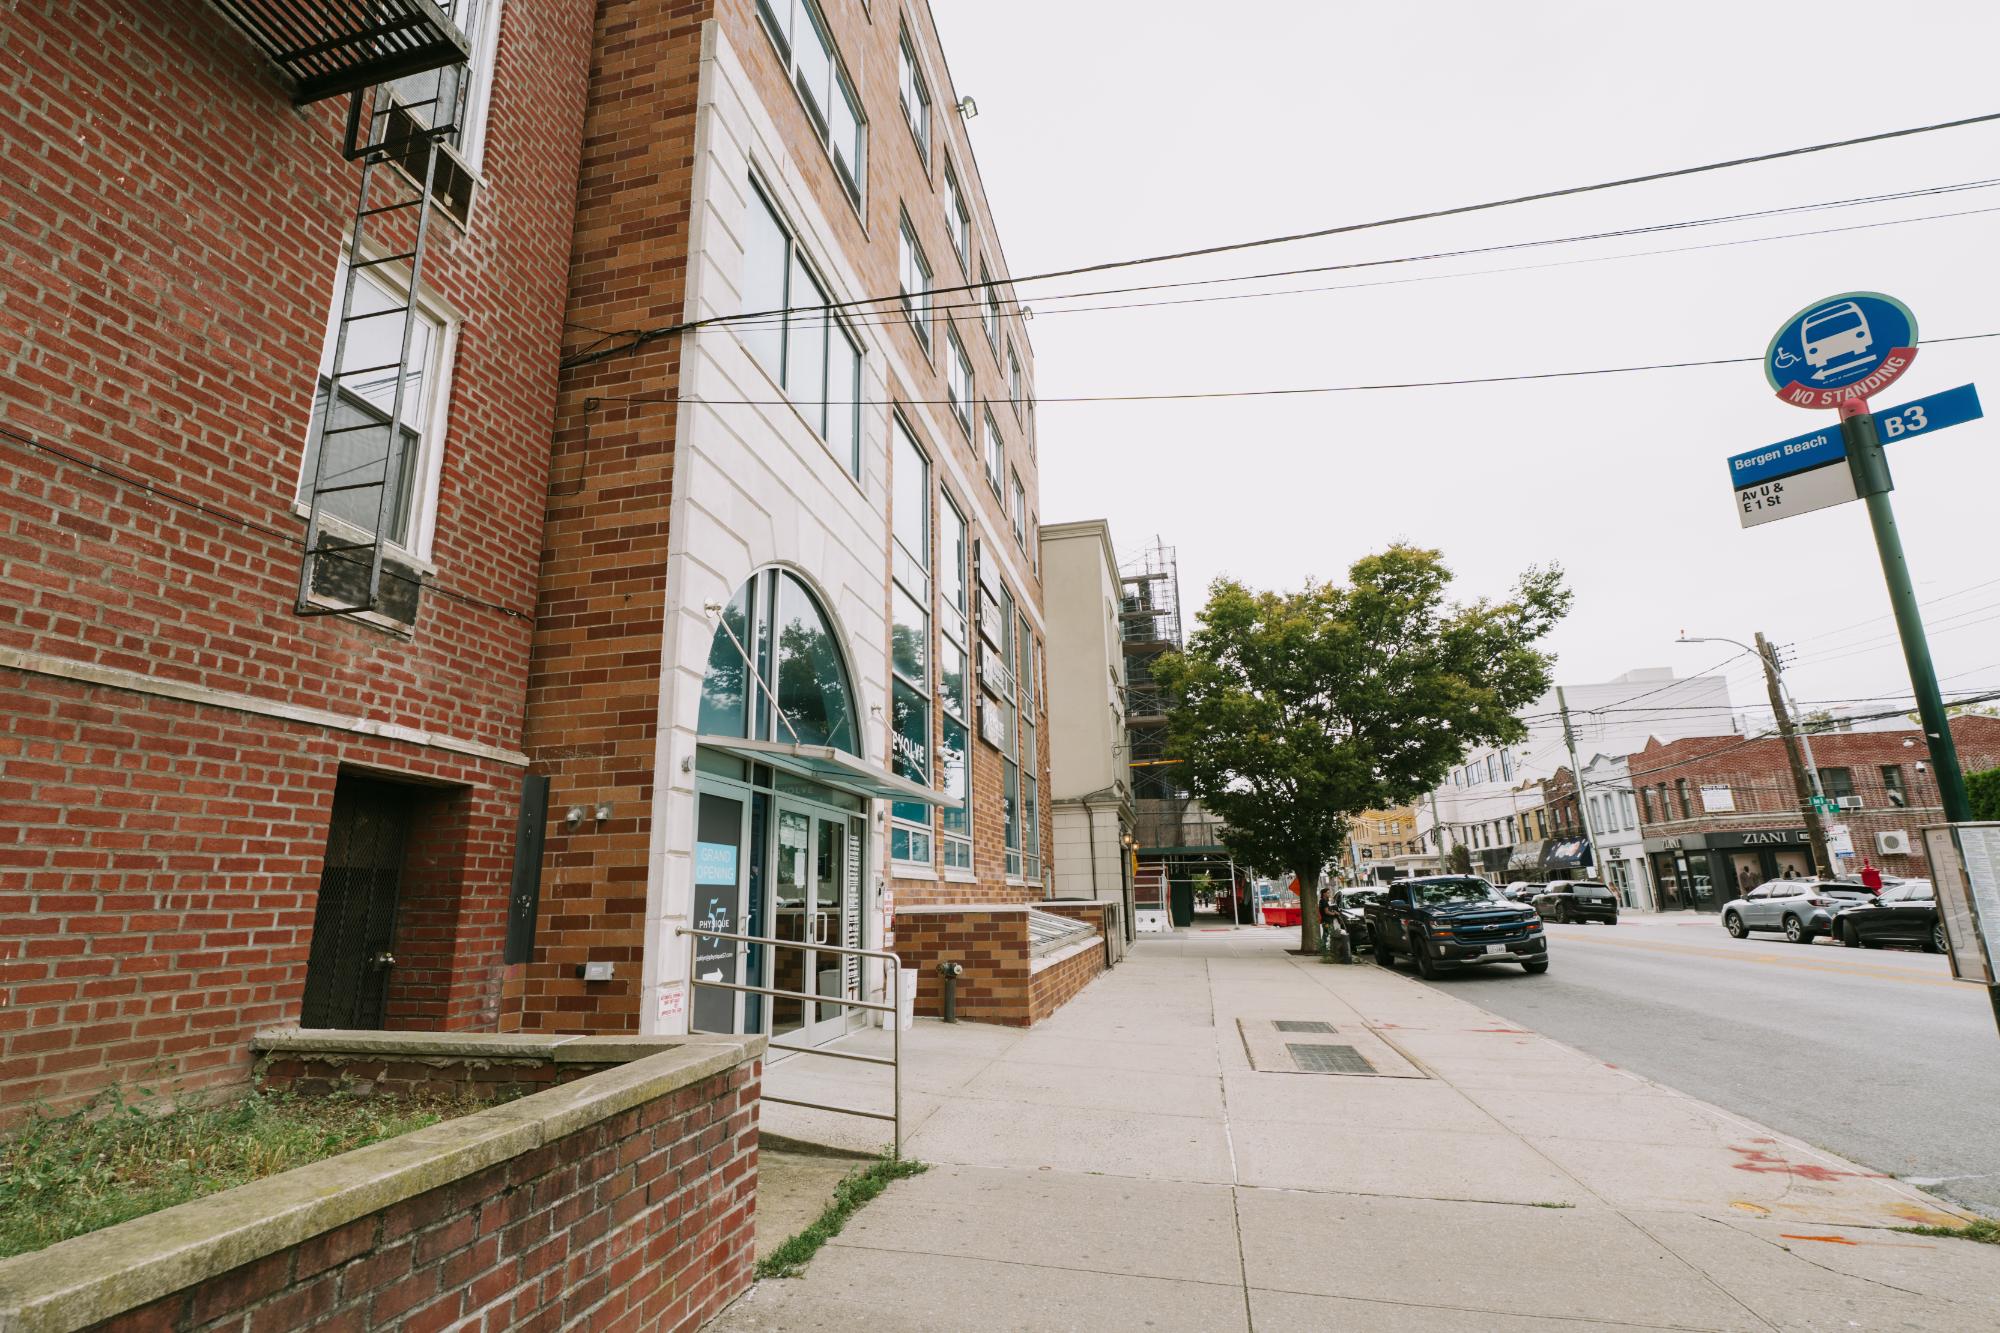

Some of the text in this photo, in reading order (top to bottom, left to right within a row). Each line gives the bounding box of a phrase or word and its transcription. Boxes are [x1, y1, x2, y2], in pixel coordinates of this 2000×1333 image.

[1790, 388, 1815, 405] NO
[1819, 356, 1906, 405] STANDING
[1884, 405, 1928, 438] B3
[1734, 435, 1828, 471] Bergen Beach
[1741, 482, 1784, 502] Av U &
[1743, 495, 1781, 513] E 1 St
[892, 730, 925, 764] EVOLVE
[1742, 831, 1788, 845] ZIANI
[702, 847, 731, 864] GRAND
[696, 864, 734, 880] OPENING
[699, 919, 730, 929] PHYSIQUE
